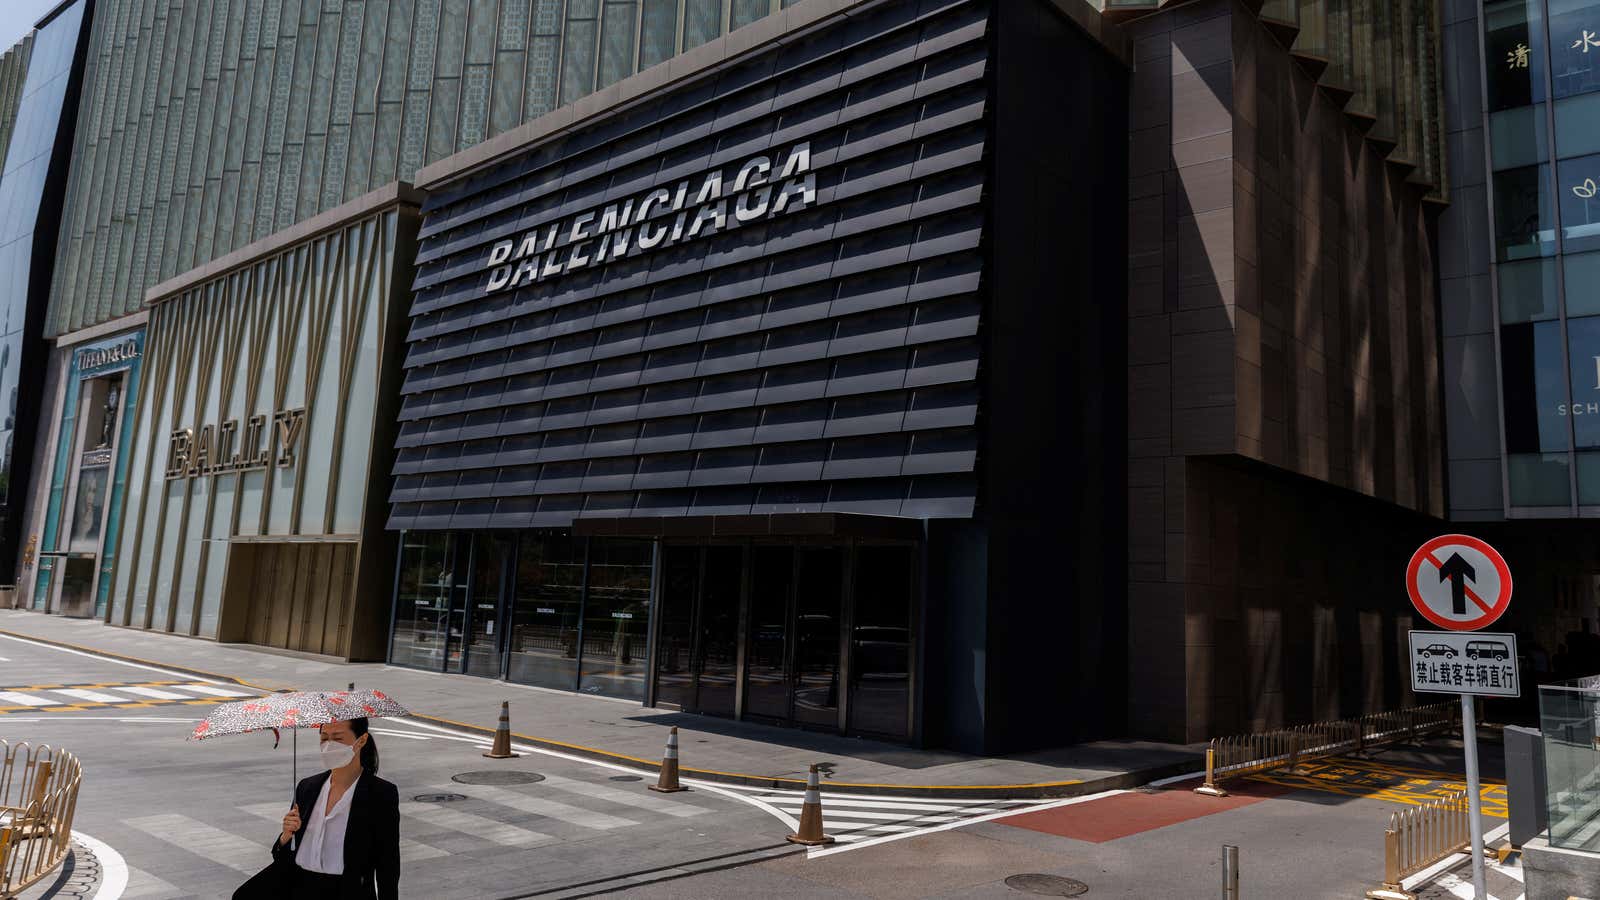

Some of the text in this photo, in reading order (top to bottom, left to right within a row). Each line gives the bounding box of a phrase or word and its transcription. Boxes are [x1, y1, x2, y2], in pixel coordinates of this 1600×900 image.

[484, 140, 817, 293] BALENCIAGA
[165, 407, 308, 481] BALLY
[1416, 660, 1514, 689] 禁止载客车辆直行
